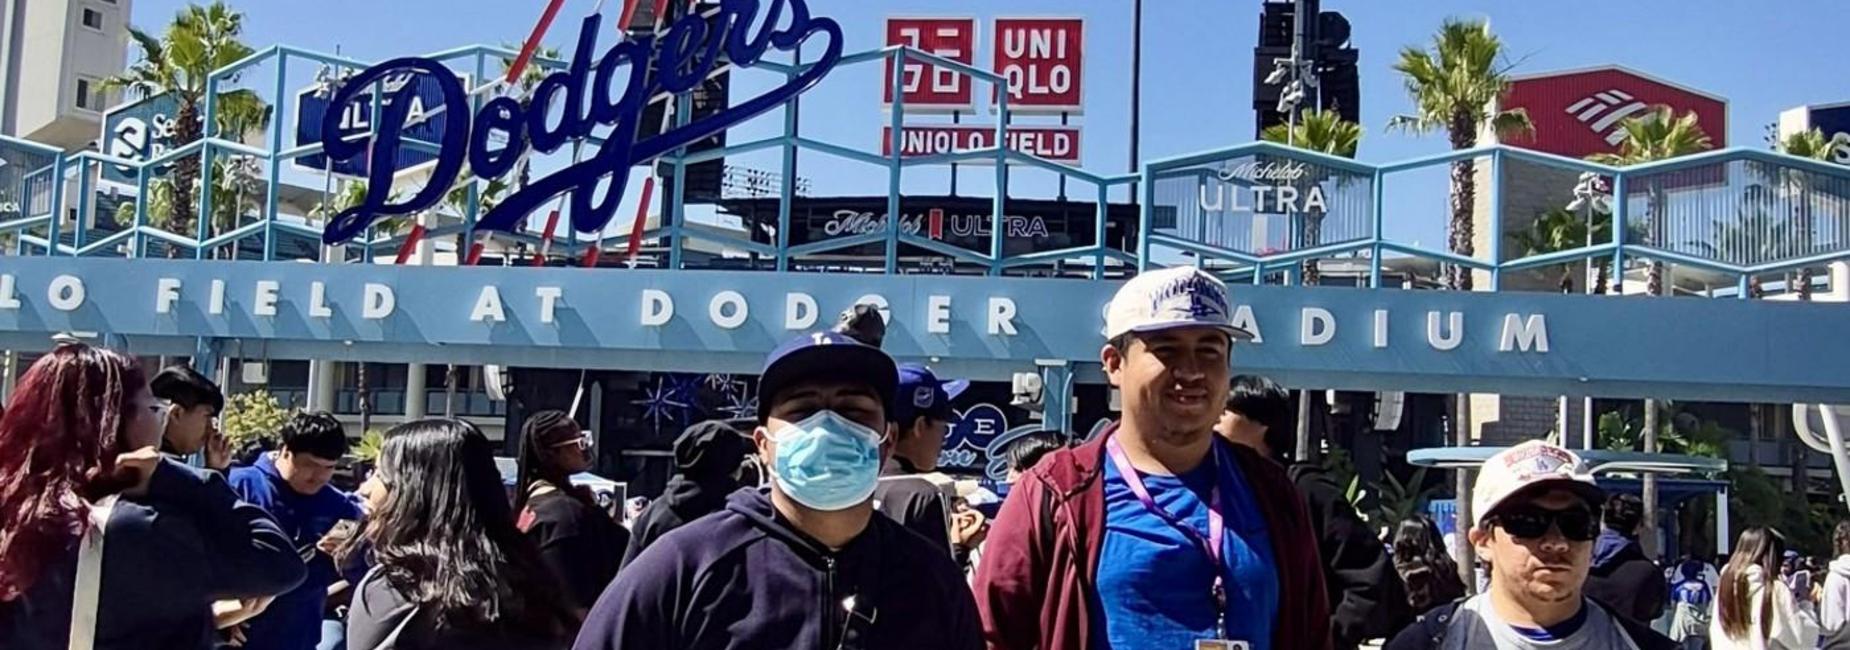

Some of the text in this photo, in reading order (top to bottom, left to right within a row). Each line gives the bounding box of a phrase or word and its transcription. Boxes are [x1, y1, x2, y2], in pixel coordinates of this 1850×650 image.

[1004, 28, 1067, 59] UNI
[1003, 64, 1071, 99] QLO
[322, 0, 843, 245] Dodgers
[1218, 160, 1307, 181] Michelob
[0, 201, 20, 212] CA
[1200, 184, 1328, 213] ULTRA
[824, 209, 924, 236] Michlob
[0, 273, 85, 311] LO
[156, 277, 396, 319] FIELD
[470, 285, 562, 324] AT
[1101, 300, 1550, 353] ADIUM
